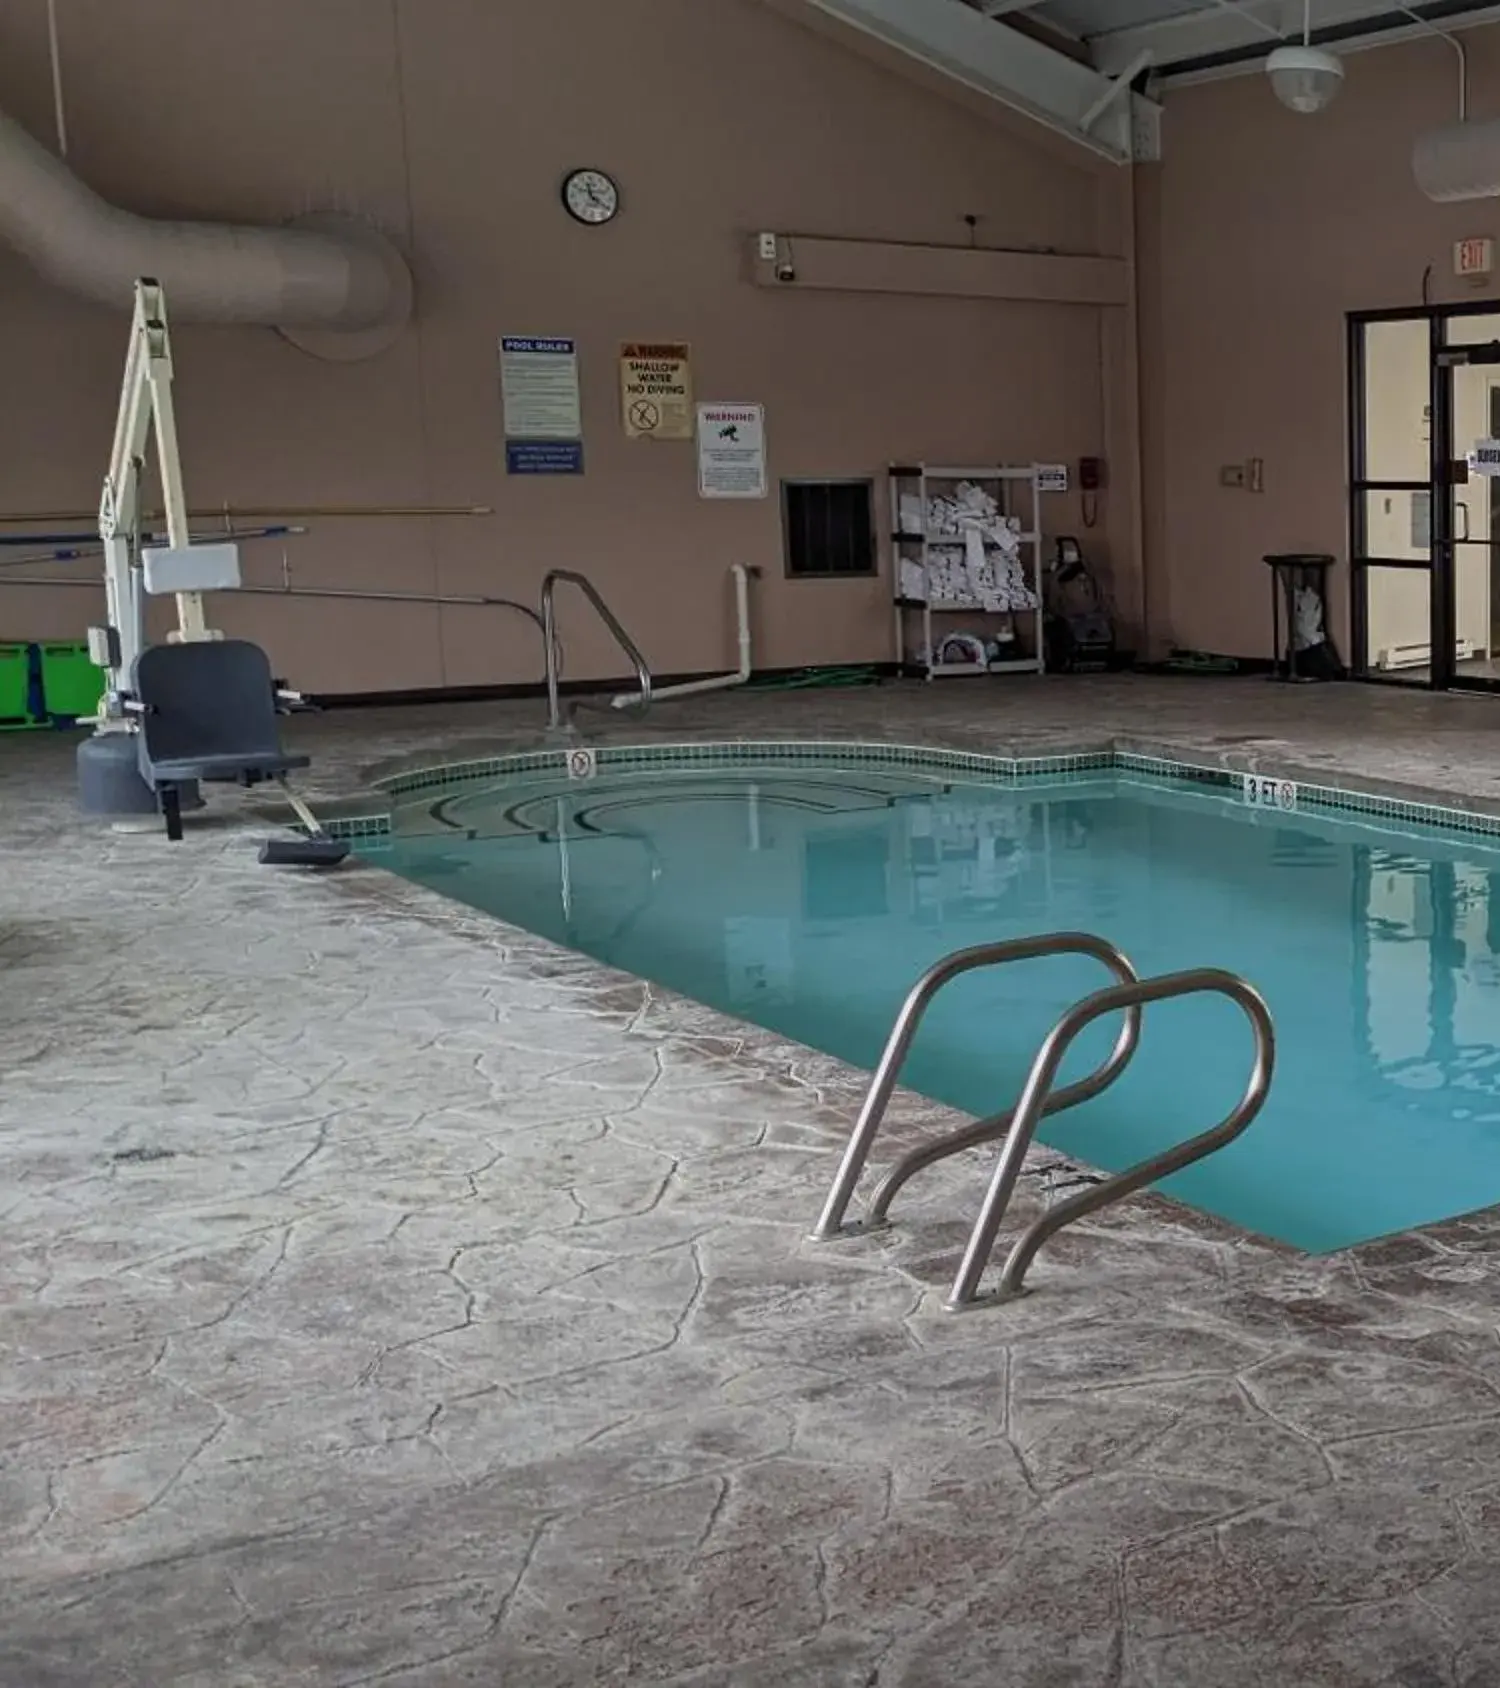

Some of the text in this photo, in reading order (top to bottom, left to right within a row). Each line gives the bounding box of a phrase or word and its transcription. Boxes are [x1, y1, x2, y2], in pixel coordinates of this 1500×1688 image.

[1461, 240, 1484, 271] EXIT
[505, 341, 570, 352] POOL RULES
[630, 362, 679, 372] SHALLOW
[638, 373, 673, 383] WATER
[628, 385, 686, 395] NO DIVING
[704, 412, 755, 422] WARNING
